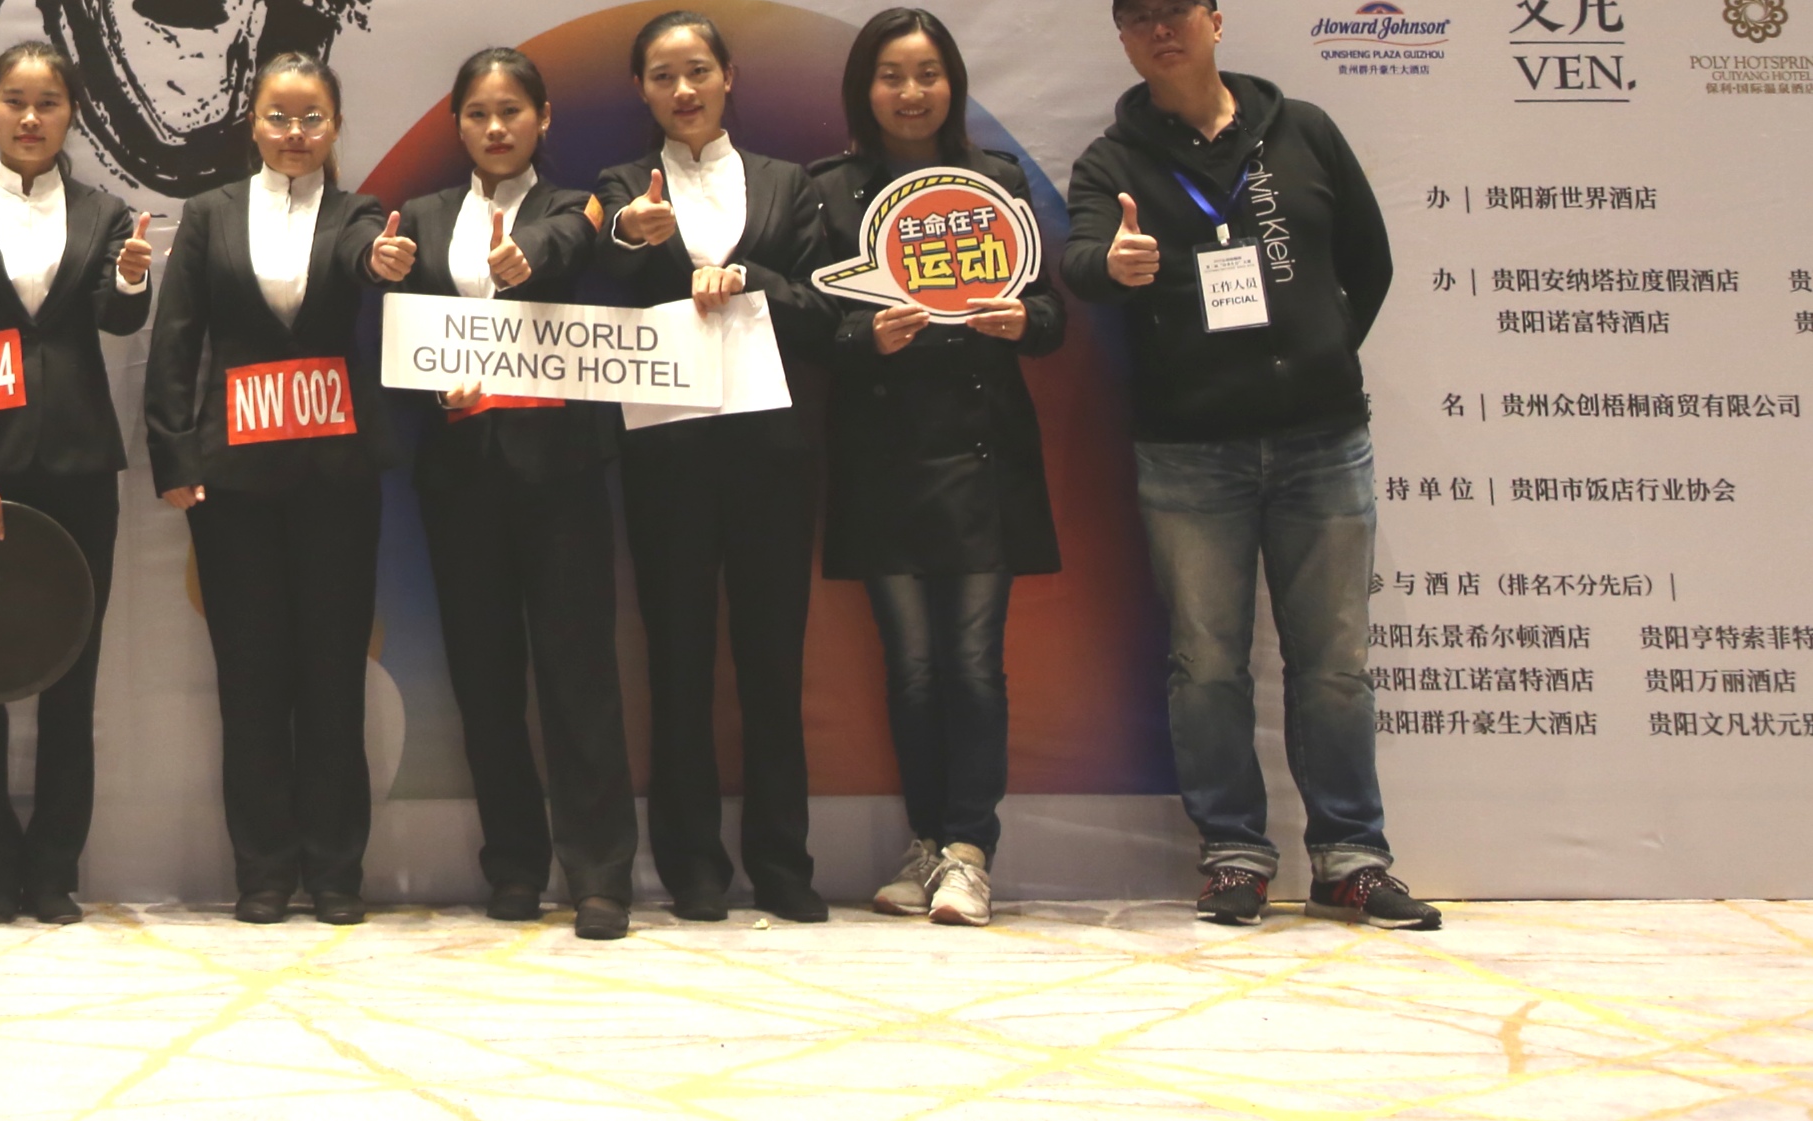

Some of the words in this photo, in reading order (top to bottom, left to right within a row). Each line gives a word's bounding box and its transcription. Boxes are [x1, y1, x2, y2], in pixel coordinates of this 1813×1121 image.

[1311, 17, 1379, 37] Howard
[1376, 16, 1446, 40] Johnson
[1321, 50, 1371, 60] QUNSHENG
[1373, 50, 1401, 59] PLAZA
[1403, 50, 1445, 59] GUIZHOU
[1689, 55, 1730, 70] POLY
[1711, 70, 1770, 81] GUIYANG
[1772, 70, 1813, 81] HOTEL
[1425, 186, 1451, 211] 办
[1484, 185, 1658, 211] 贵阳新世界酒店
[898, 207, 998, 242] 生命在于
[1258, 217, 1296, 283] Klein
[903, 233, 1011, 294] 运动
[1432, 267, 1457, 293] 办
[1490, 267, 1740, 293] 贵阳安纳塔拉度假酒店
[1211, 294, 1259, 308] OFFICIAL
[444, 312, 521, 344] NEW
[532, 318, 660, 352] WORLD
[1496, 309, 1671, 335] 贵阳诺富特酒店
[412, 346, 567, 382] GUIYANG
[577, 356, 692, 389] HOTEL
[234, 377, 286, 433] NW
[292, 367, 345, 427] 002
[1441, 392, 1465, 417] 名
[1500, 392, 1802, 418] 贵州众创梧桐商贸有限公司
[1374, 477, 1475, 503] 持单位
[1509, 476, 1737, 502] 贵阳市饭店行业协会
[1368, 623, 1591, 649] 贵阳东景希尔顿酒店
[1369, 667, 1594, 693] 贵阳盘江诺富特酒店
[1644, 668, 1797, 694] 贵阳万丽酒店
[1375, 710, 1598, 737] 贵阳群升豪生大酒店
